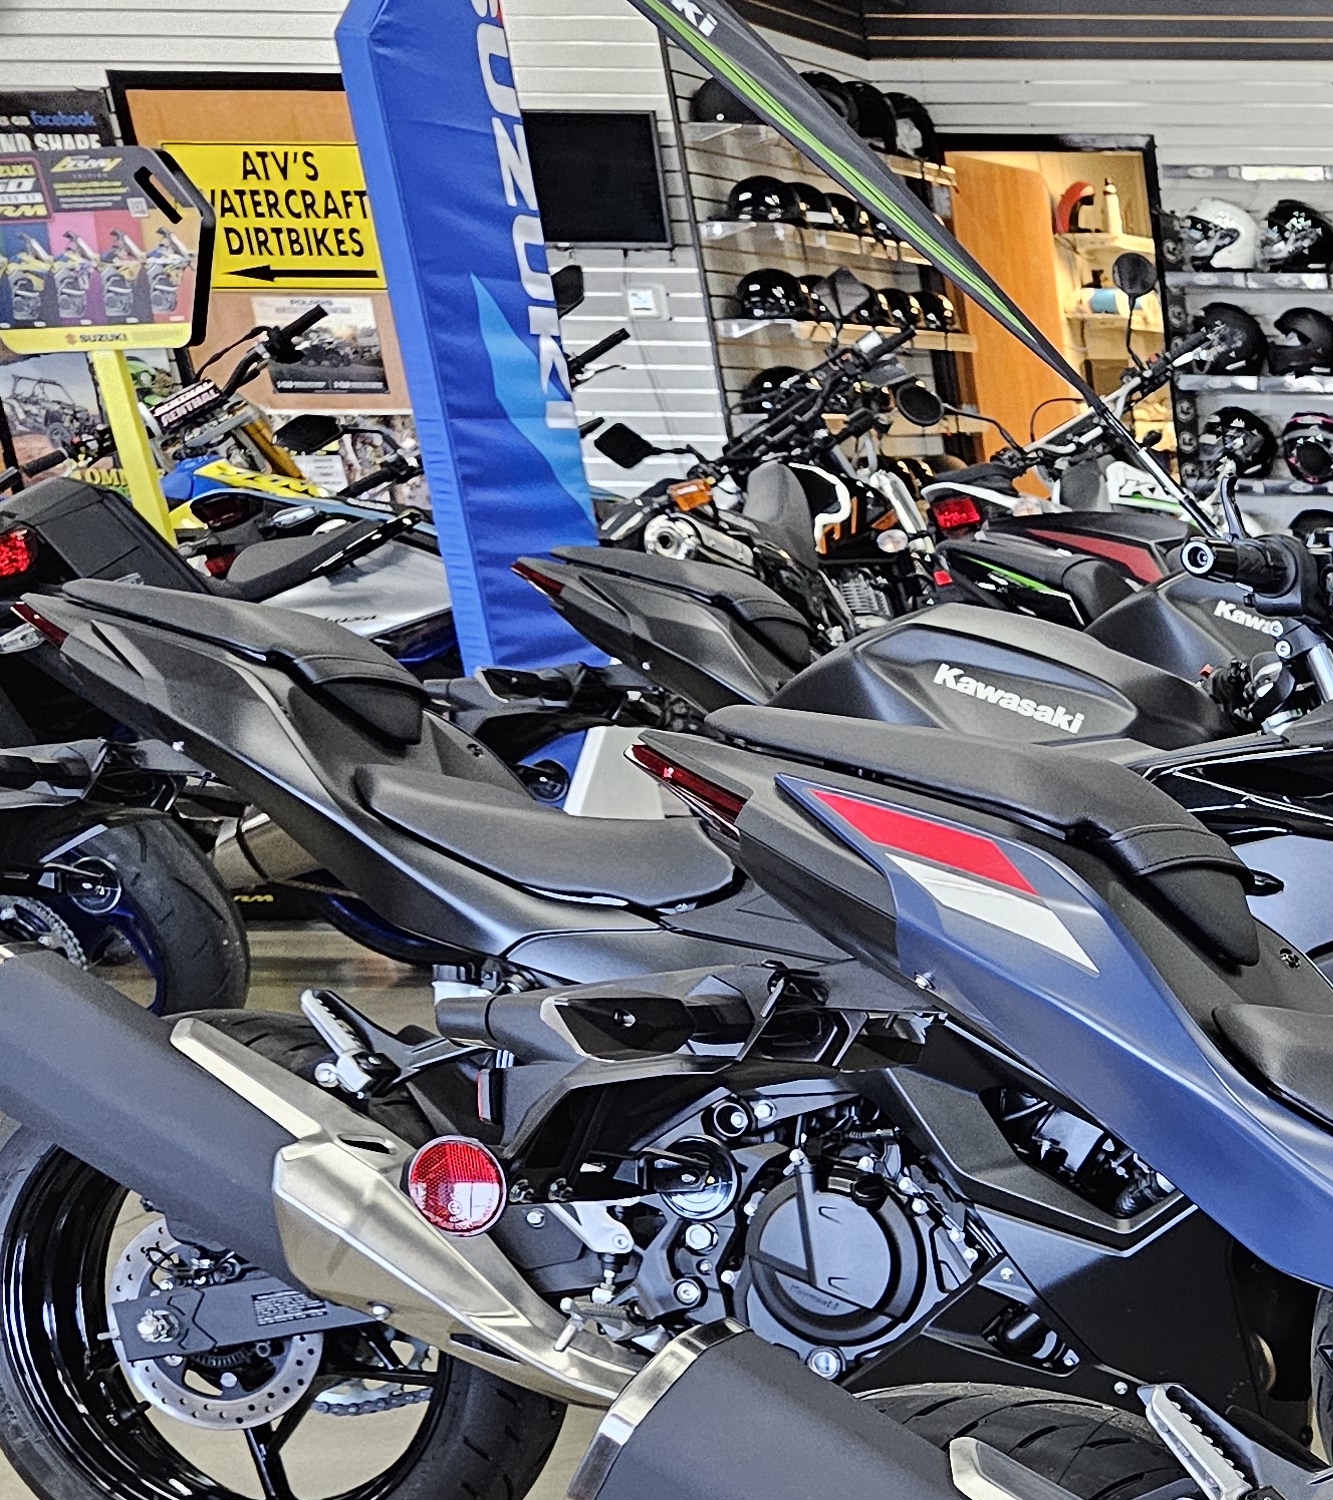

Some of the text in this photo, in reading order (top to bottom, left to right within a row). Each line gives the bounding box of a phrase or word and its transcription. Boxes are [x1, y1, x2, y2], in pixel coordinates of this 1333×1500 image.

[242, 151, 319, 181] ATV'S
[210, 189, 368, 219] ATERCRAFT
[470, 0, 579, 430] UZUKI
[223, 227, 365, 257] DIRTBIKES
[933, 663, 1085, 734] Kawasaki
